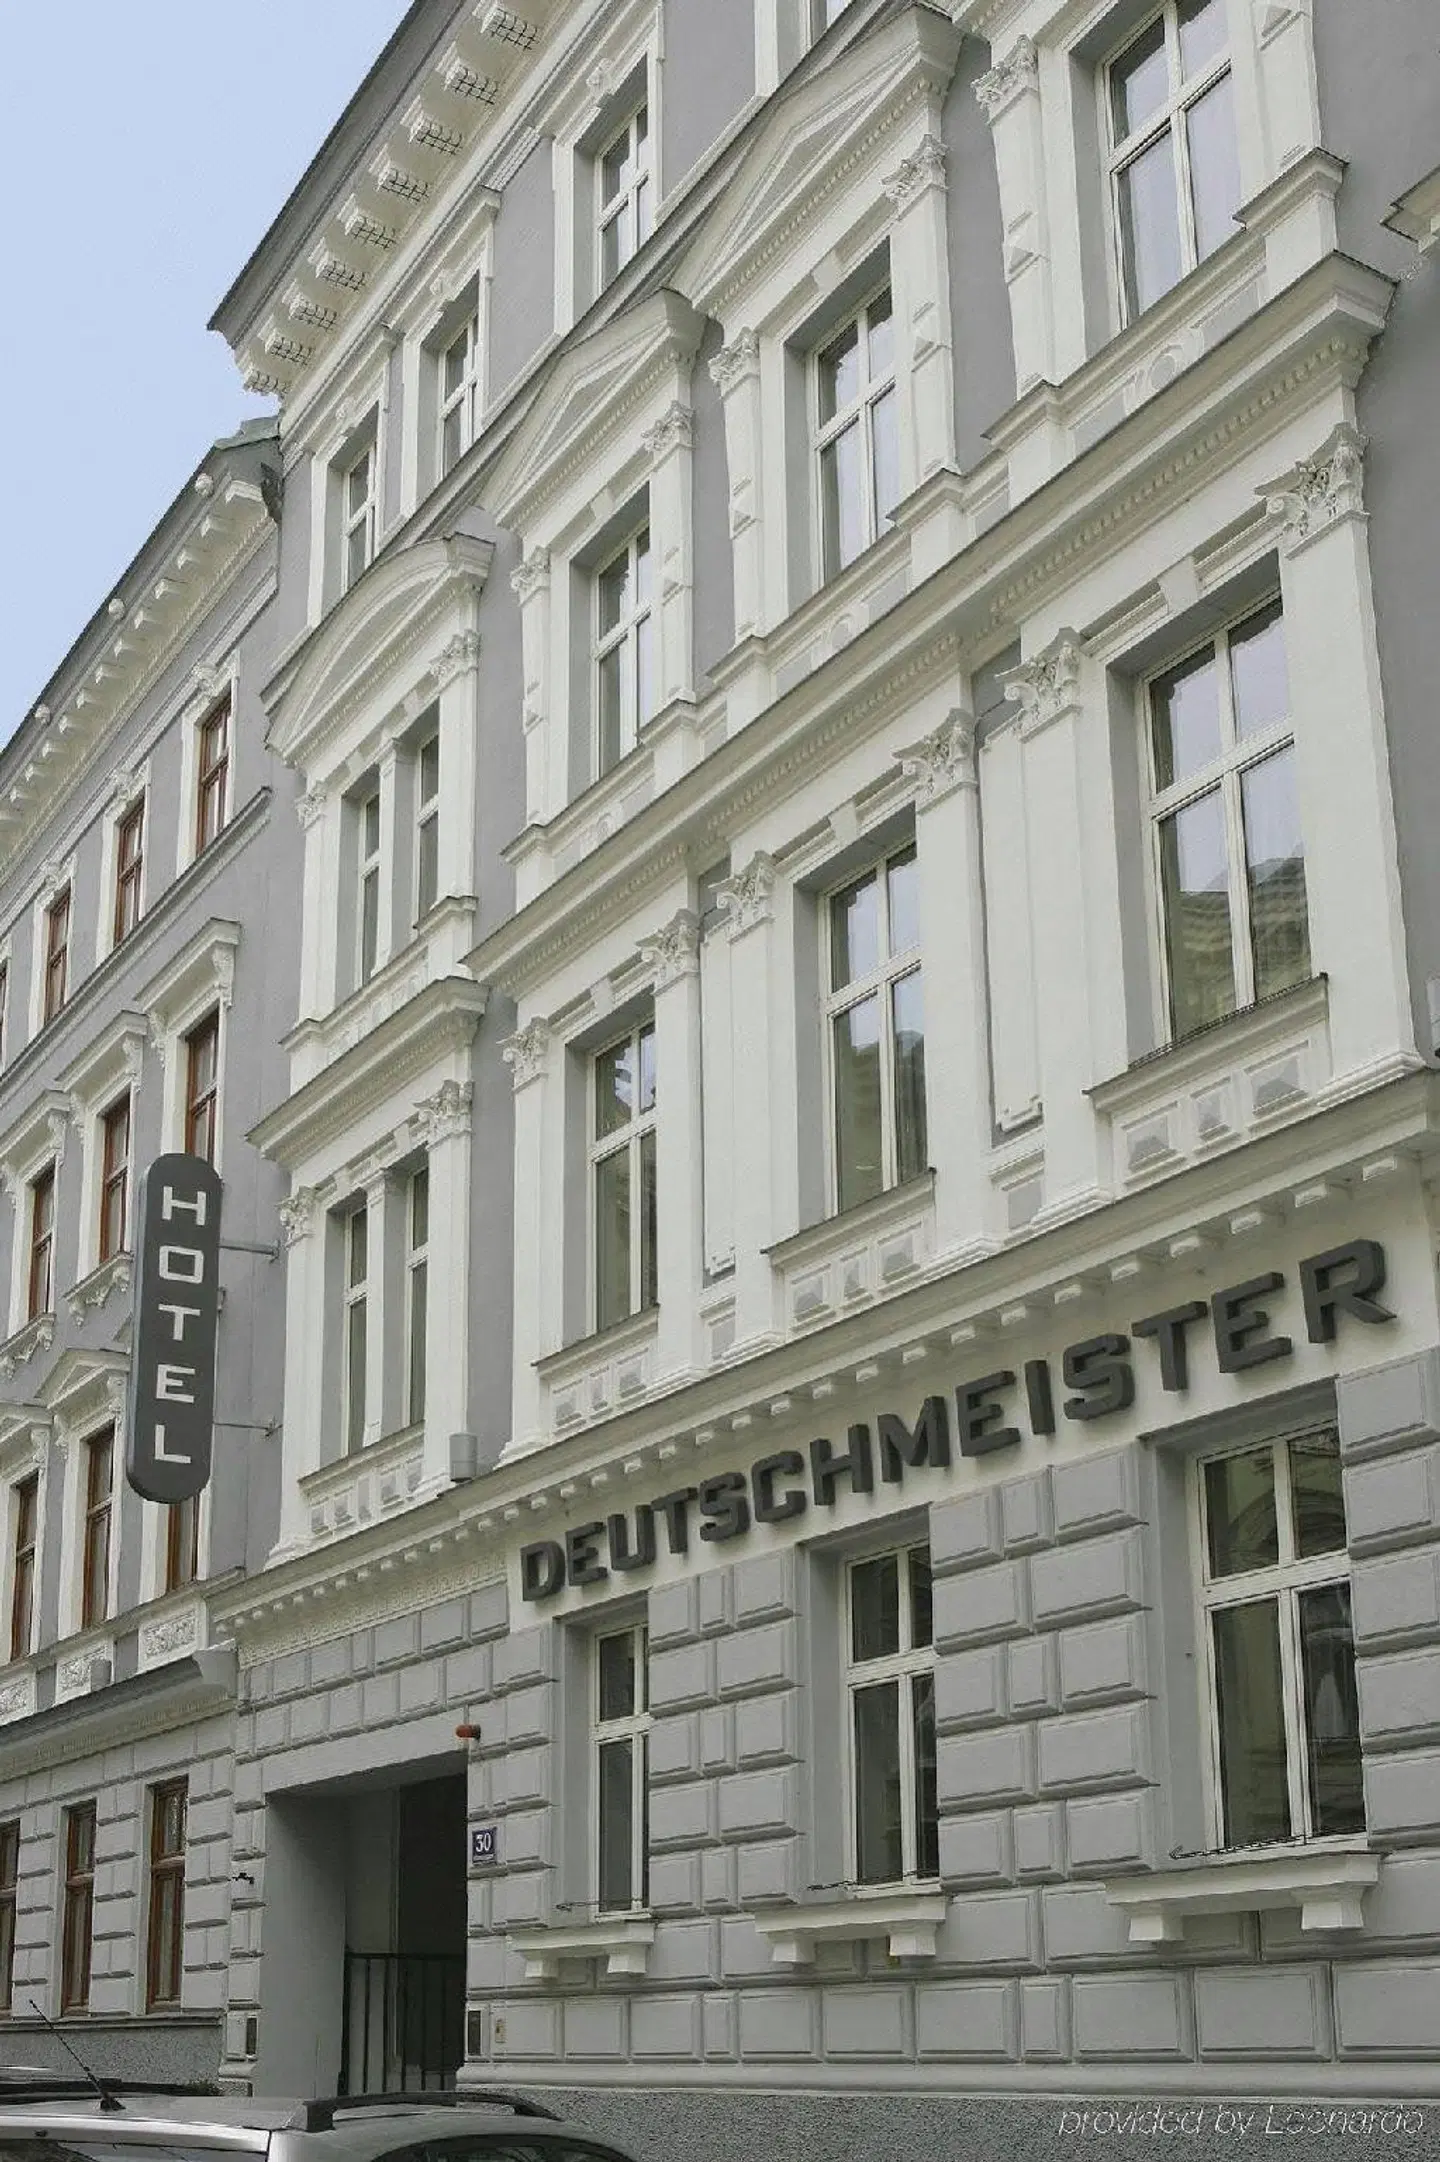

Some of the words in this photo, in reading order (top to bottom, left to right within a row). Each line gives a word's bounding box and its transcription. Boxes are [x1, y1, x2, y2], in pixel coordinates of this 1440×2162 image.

[153, 1185, 206, 1464] HOTEL
[520, 1238, 1397, 1603] DEUTSCHMEISTER
[475, 1832, 492, 1852] 30
